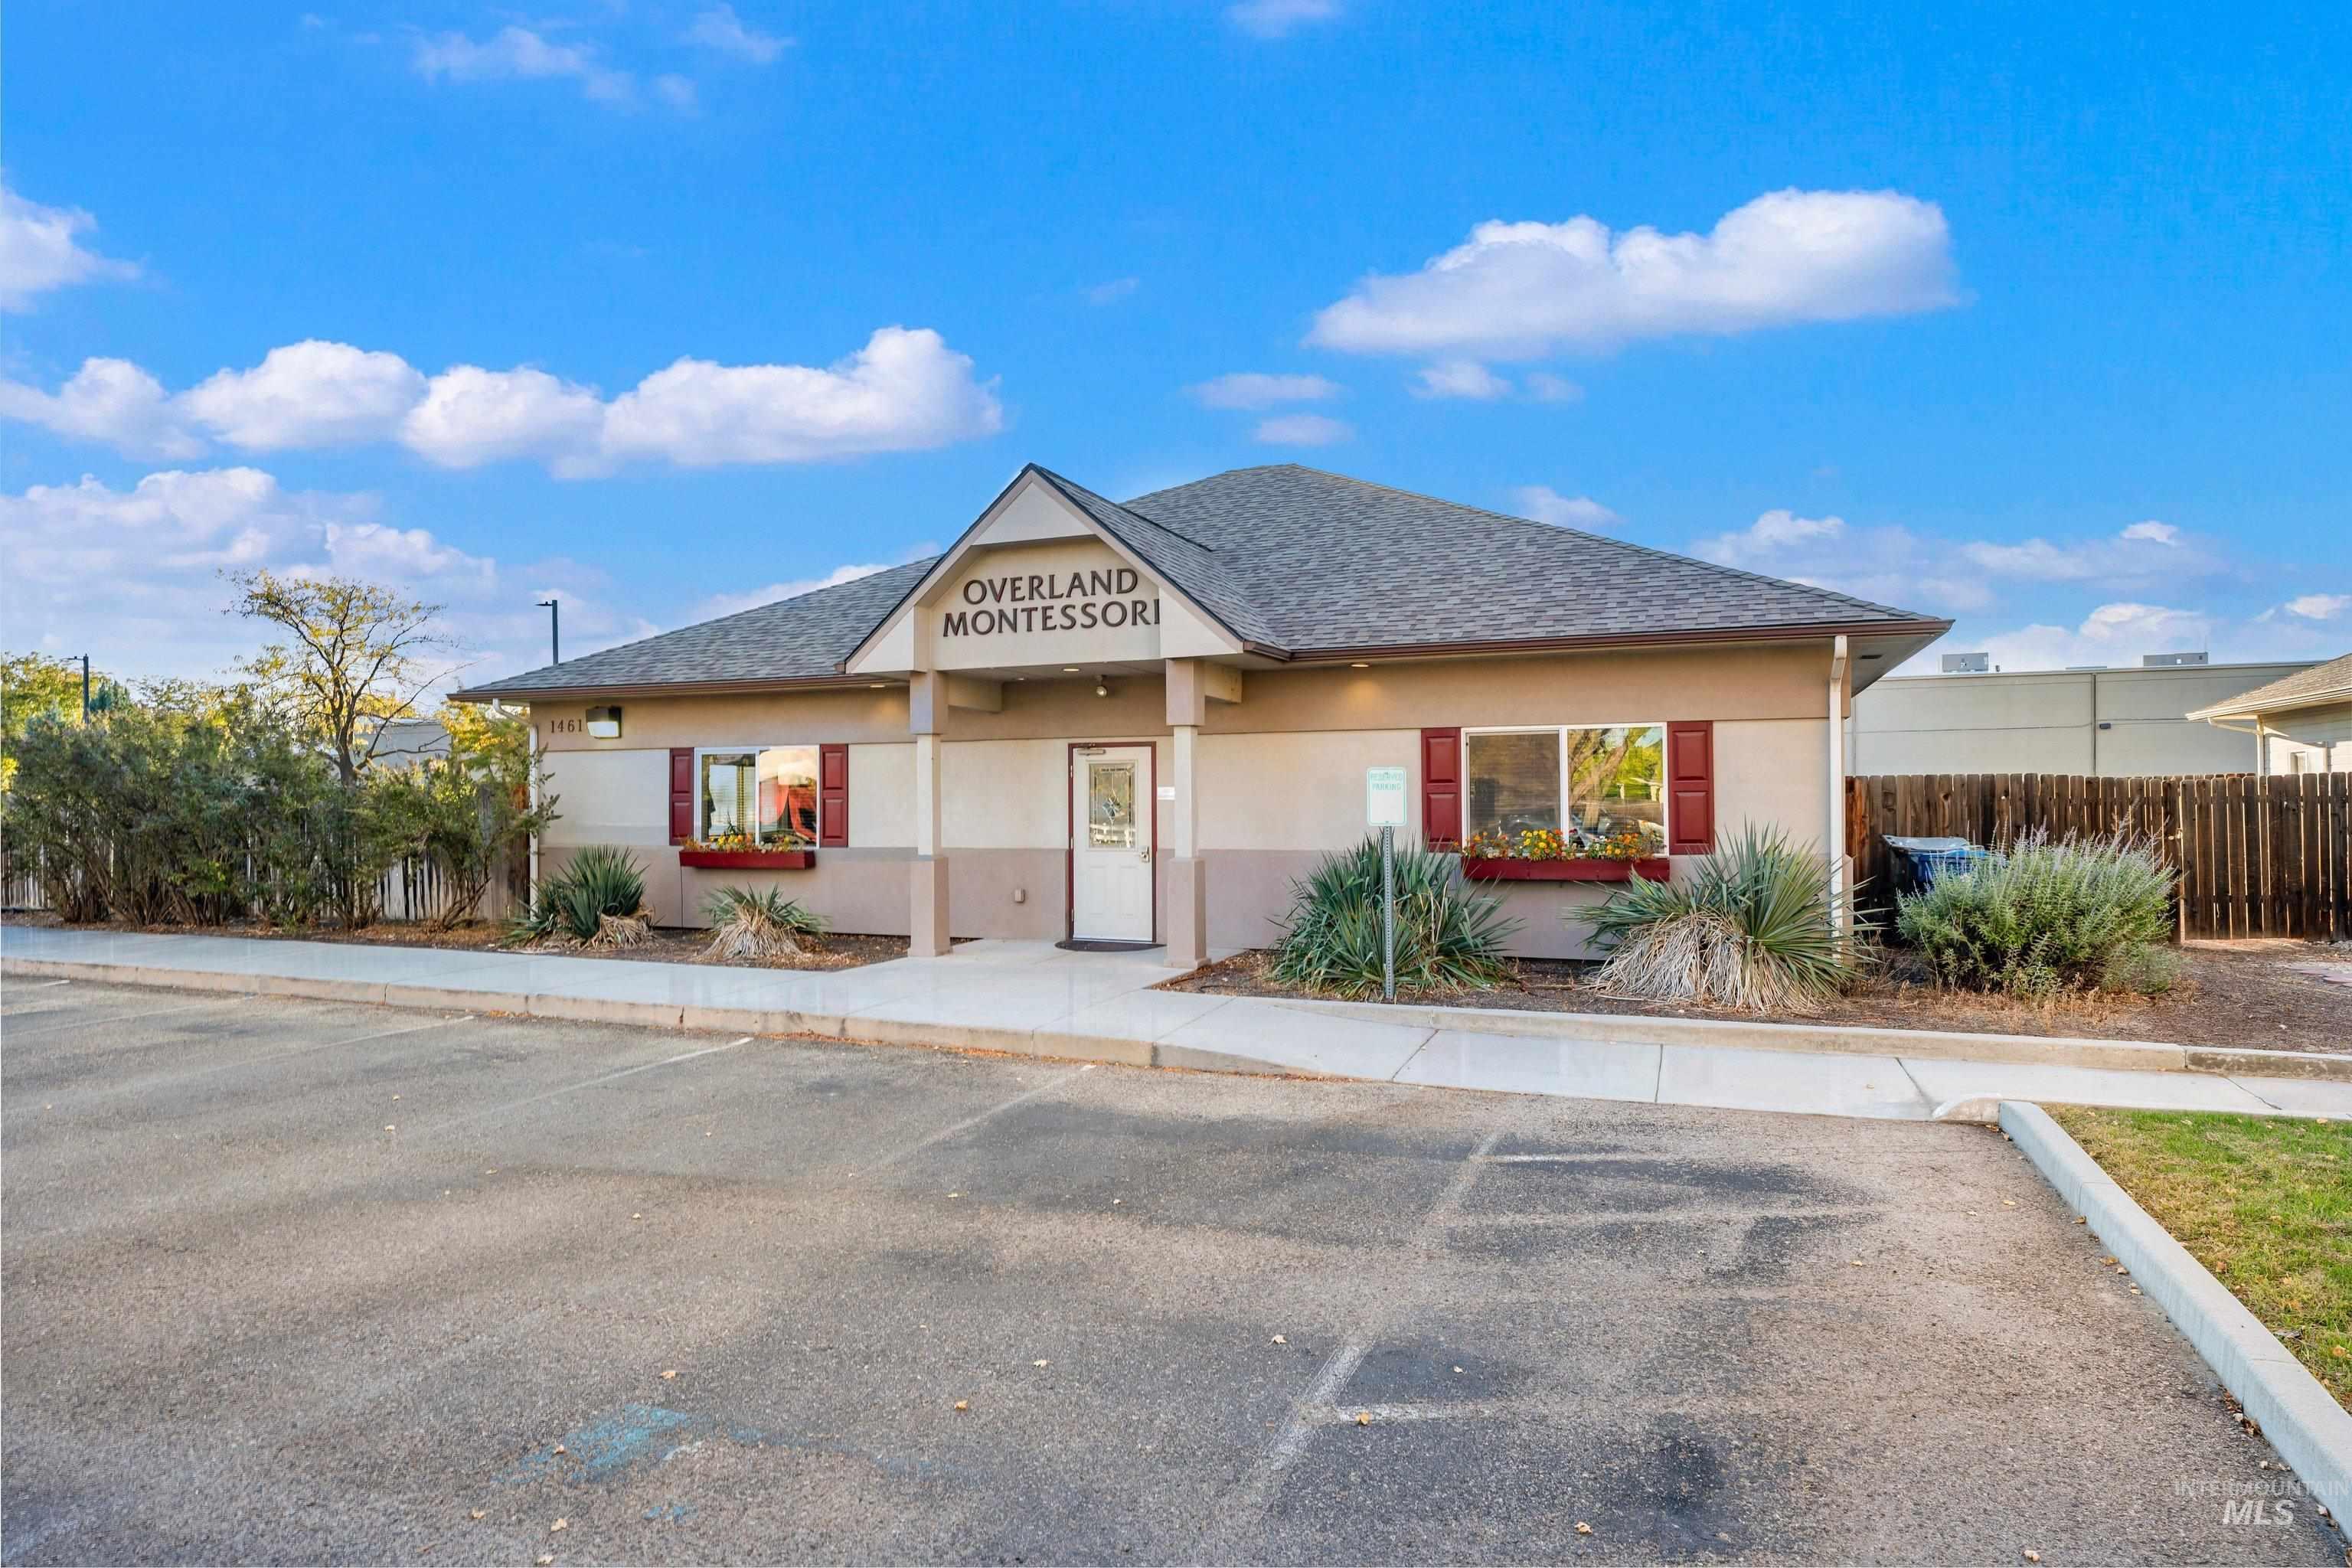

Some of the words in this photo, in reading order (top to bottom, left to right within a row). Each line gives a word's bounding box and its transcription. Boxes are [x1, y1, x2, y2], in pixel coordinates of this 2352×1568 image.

[962, 568, 1138, 606] OVERLAND
[942, 599, 1160, 637] MONTESSORI
[550, 719, 583, 733] 1461
